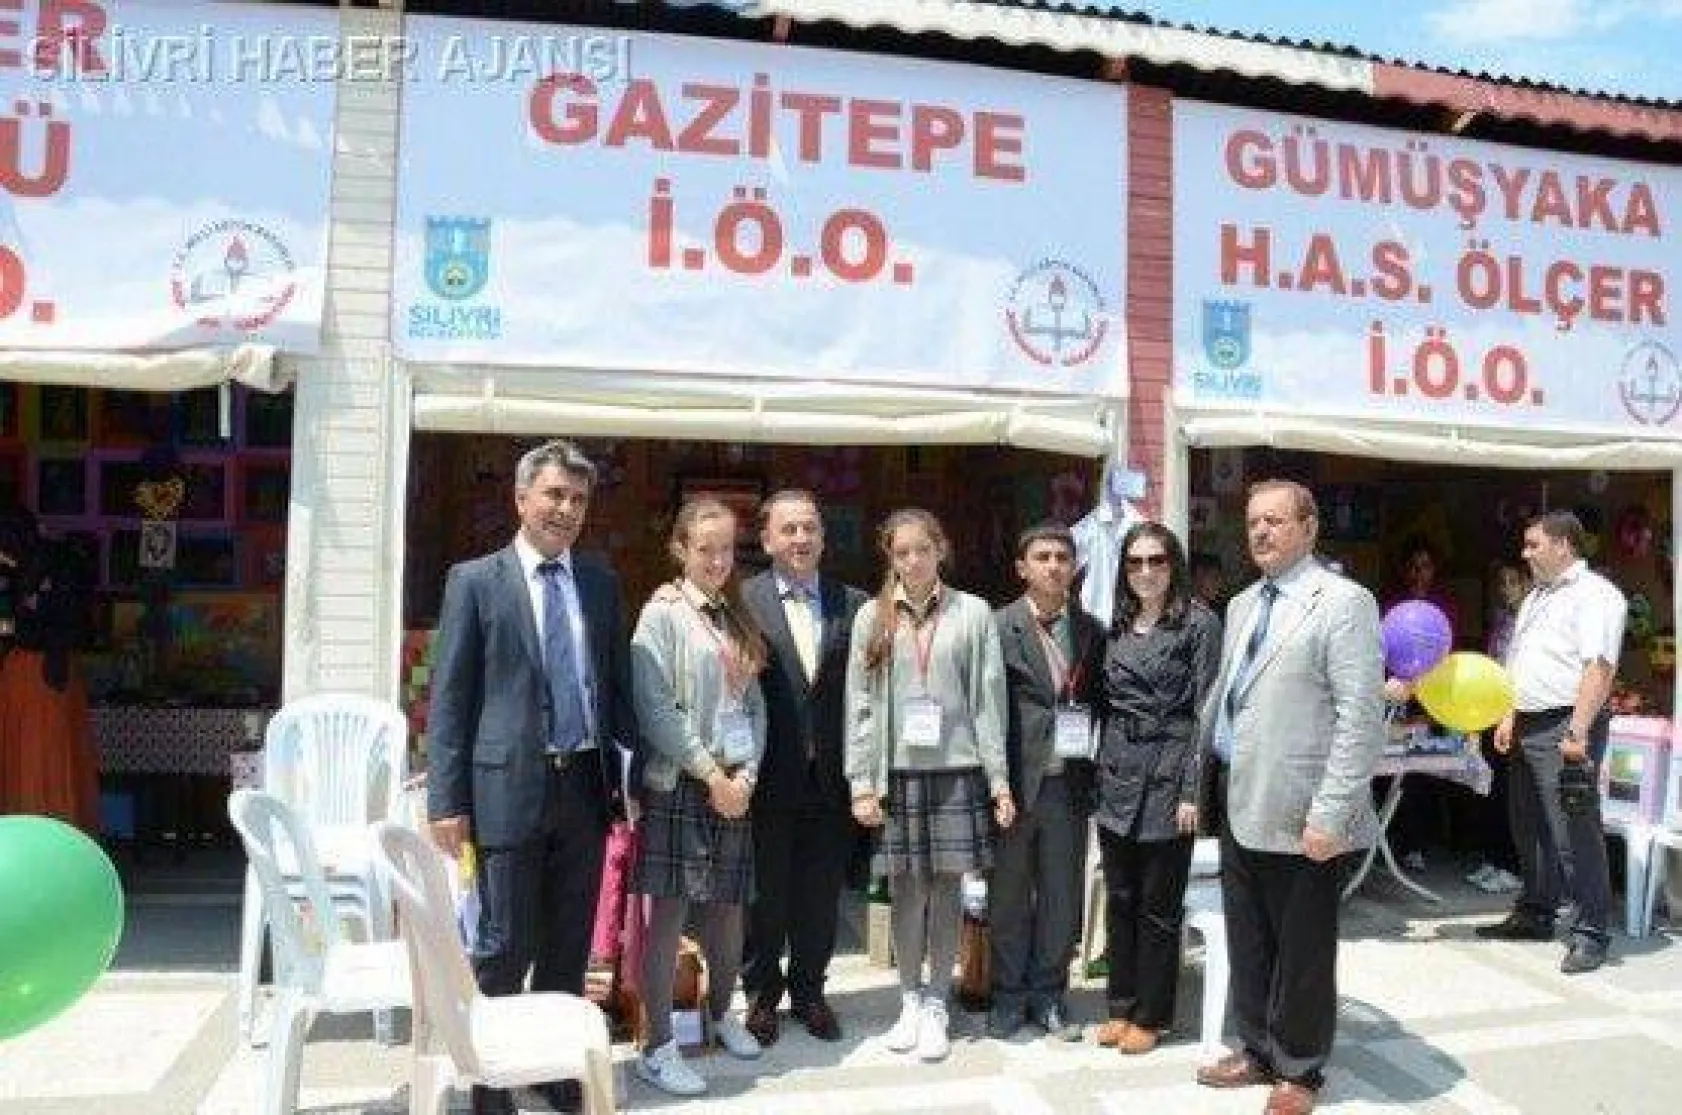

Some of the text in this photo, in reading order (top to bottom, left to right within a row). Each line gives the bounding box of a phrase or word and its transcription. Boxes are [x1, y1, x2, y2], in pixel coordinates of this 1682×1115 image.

[528, 73, 1026, 182] GAZİTEPE
[1224, 124, 1661, 237] GÜMÜŞYAKA
[649, 178, 914, 285] İ.Ö.O.
[1220, 223, 1667, 331] H.A.S. ÖLÇER
[1368, 320, 1545, 405] İ.Ö.O.
